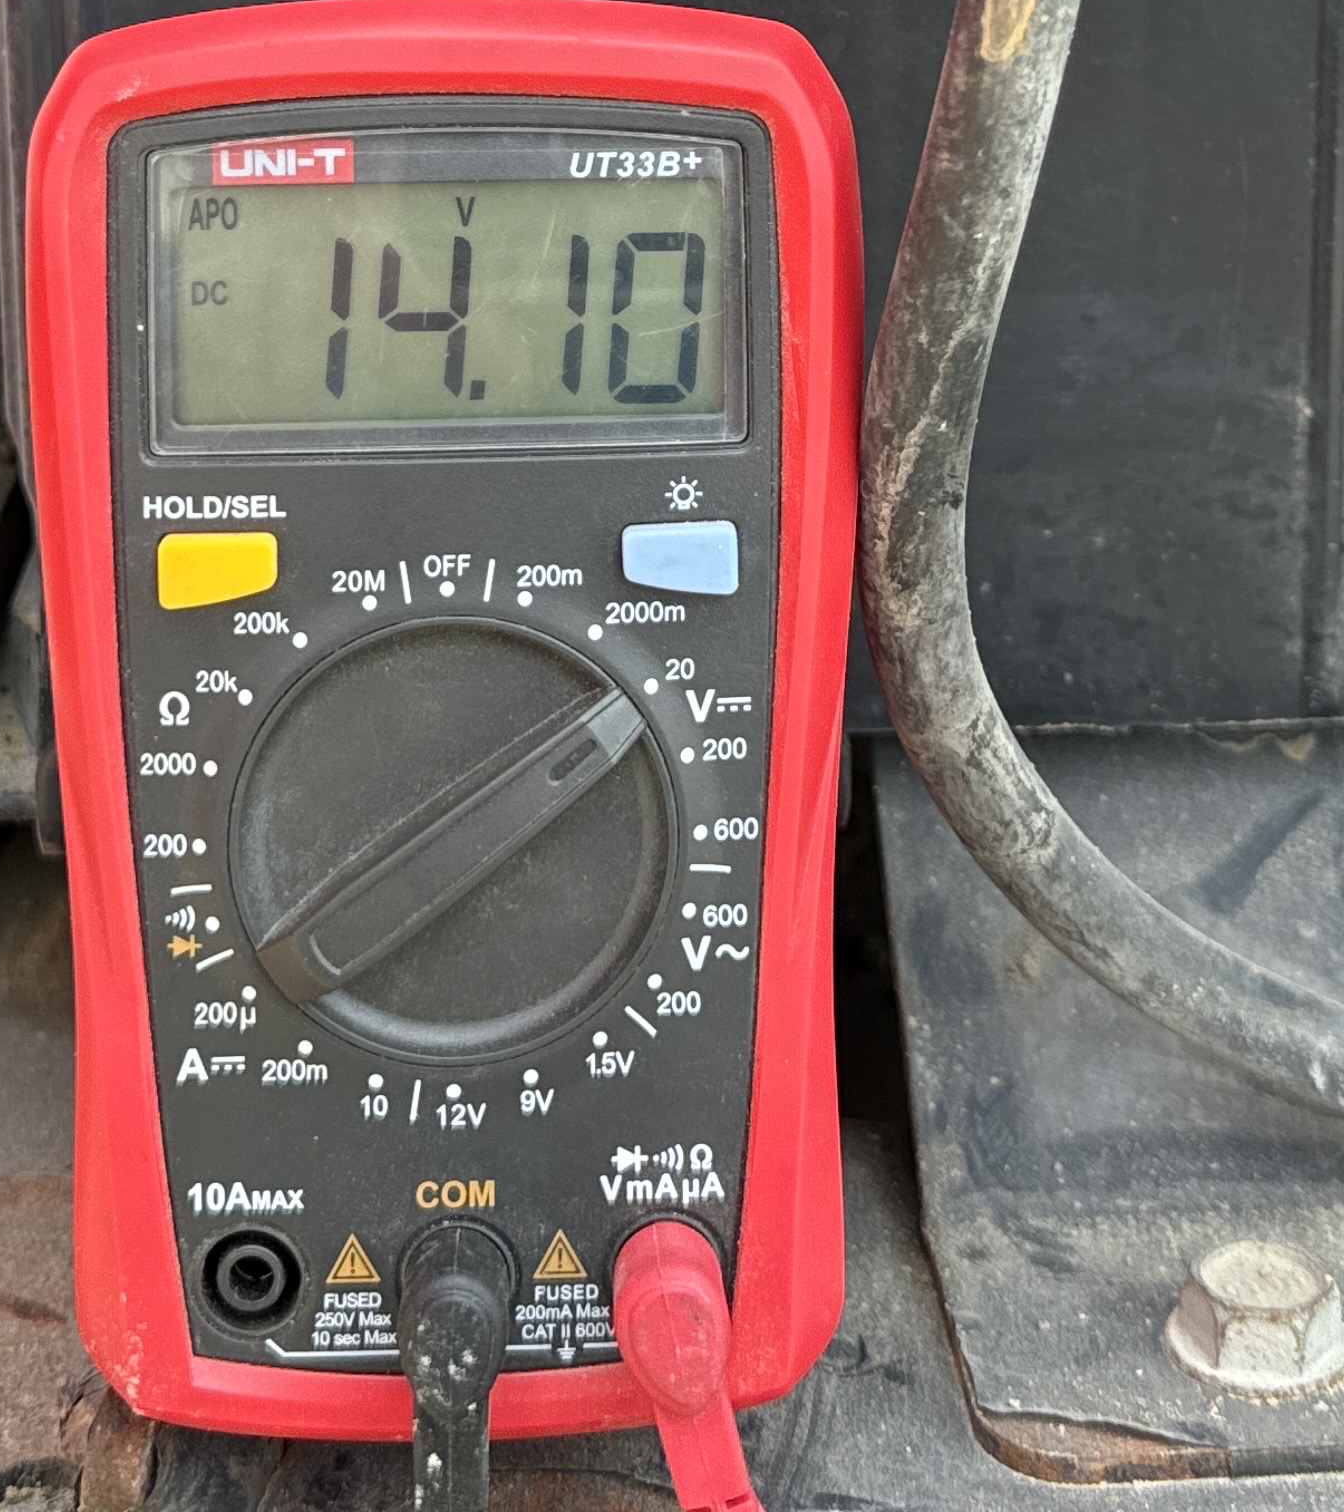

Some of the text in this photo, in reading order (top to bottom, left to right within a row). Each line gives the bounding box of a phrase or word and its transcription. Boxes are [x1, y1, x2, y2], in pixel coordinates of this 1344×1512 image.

[219, 148, 346, 176] UNI-T
[568, 151, 703, 179] UT33B+
[188, 197, 238, 231] APO
[455, 196, 476, 227] V
[190, 281, 228, 306] DC
[324, 232, 705, 404] 14.10
[142, 495, 287, 519] HOLD/SEL
[423, 554, 471, 577] OFF
[517, 564, 583, 587] 200m
[331, 569, 386, 593] 20M
[233, 611, 290, 635] 200k
[605, 601, 686, 624] 2000m
[665, 657, 695, 681] 20
[195, 670, 238, 693] 20k
[702, 737, 747, 760] 200
[140, 753, 197, 776] 2000
[713, 816, 759, 840] 600
[143, 834, 188, 858] 200
[702, 903, 748, 927] 600
[656, 990, 701, 1015] 200
[262, 1059, 328, 1085] 200m
[585, 1050, 635, 1076] 1.5V
[359, 1095, 389, 1120] 10
[520, 1089, 555, 1115] 9V
[436, 1102, 487, 1129] 12V
[415, 1180, 496, 1208] COM
[323, 1292, 383, 1310] FUSED
[533, 1284, 599, 1302] FUSED
[314, 1312, 392, 1329] 250V Max
[515, 1303, 611, 1322] 200mA Max
[311, 1329, 398, 1346] 10 sec Max
[521, 1324, 556, 1340] CAT
